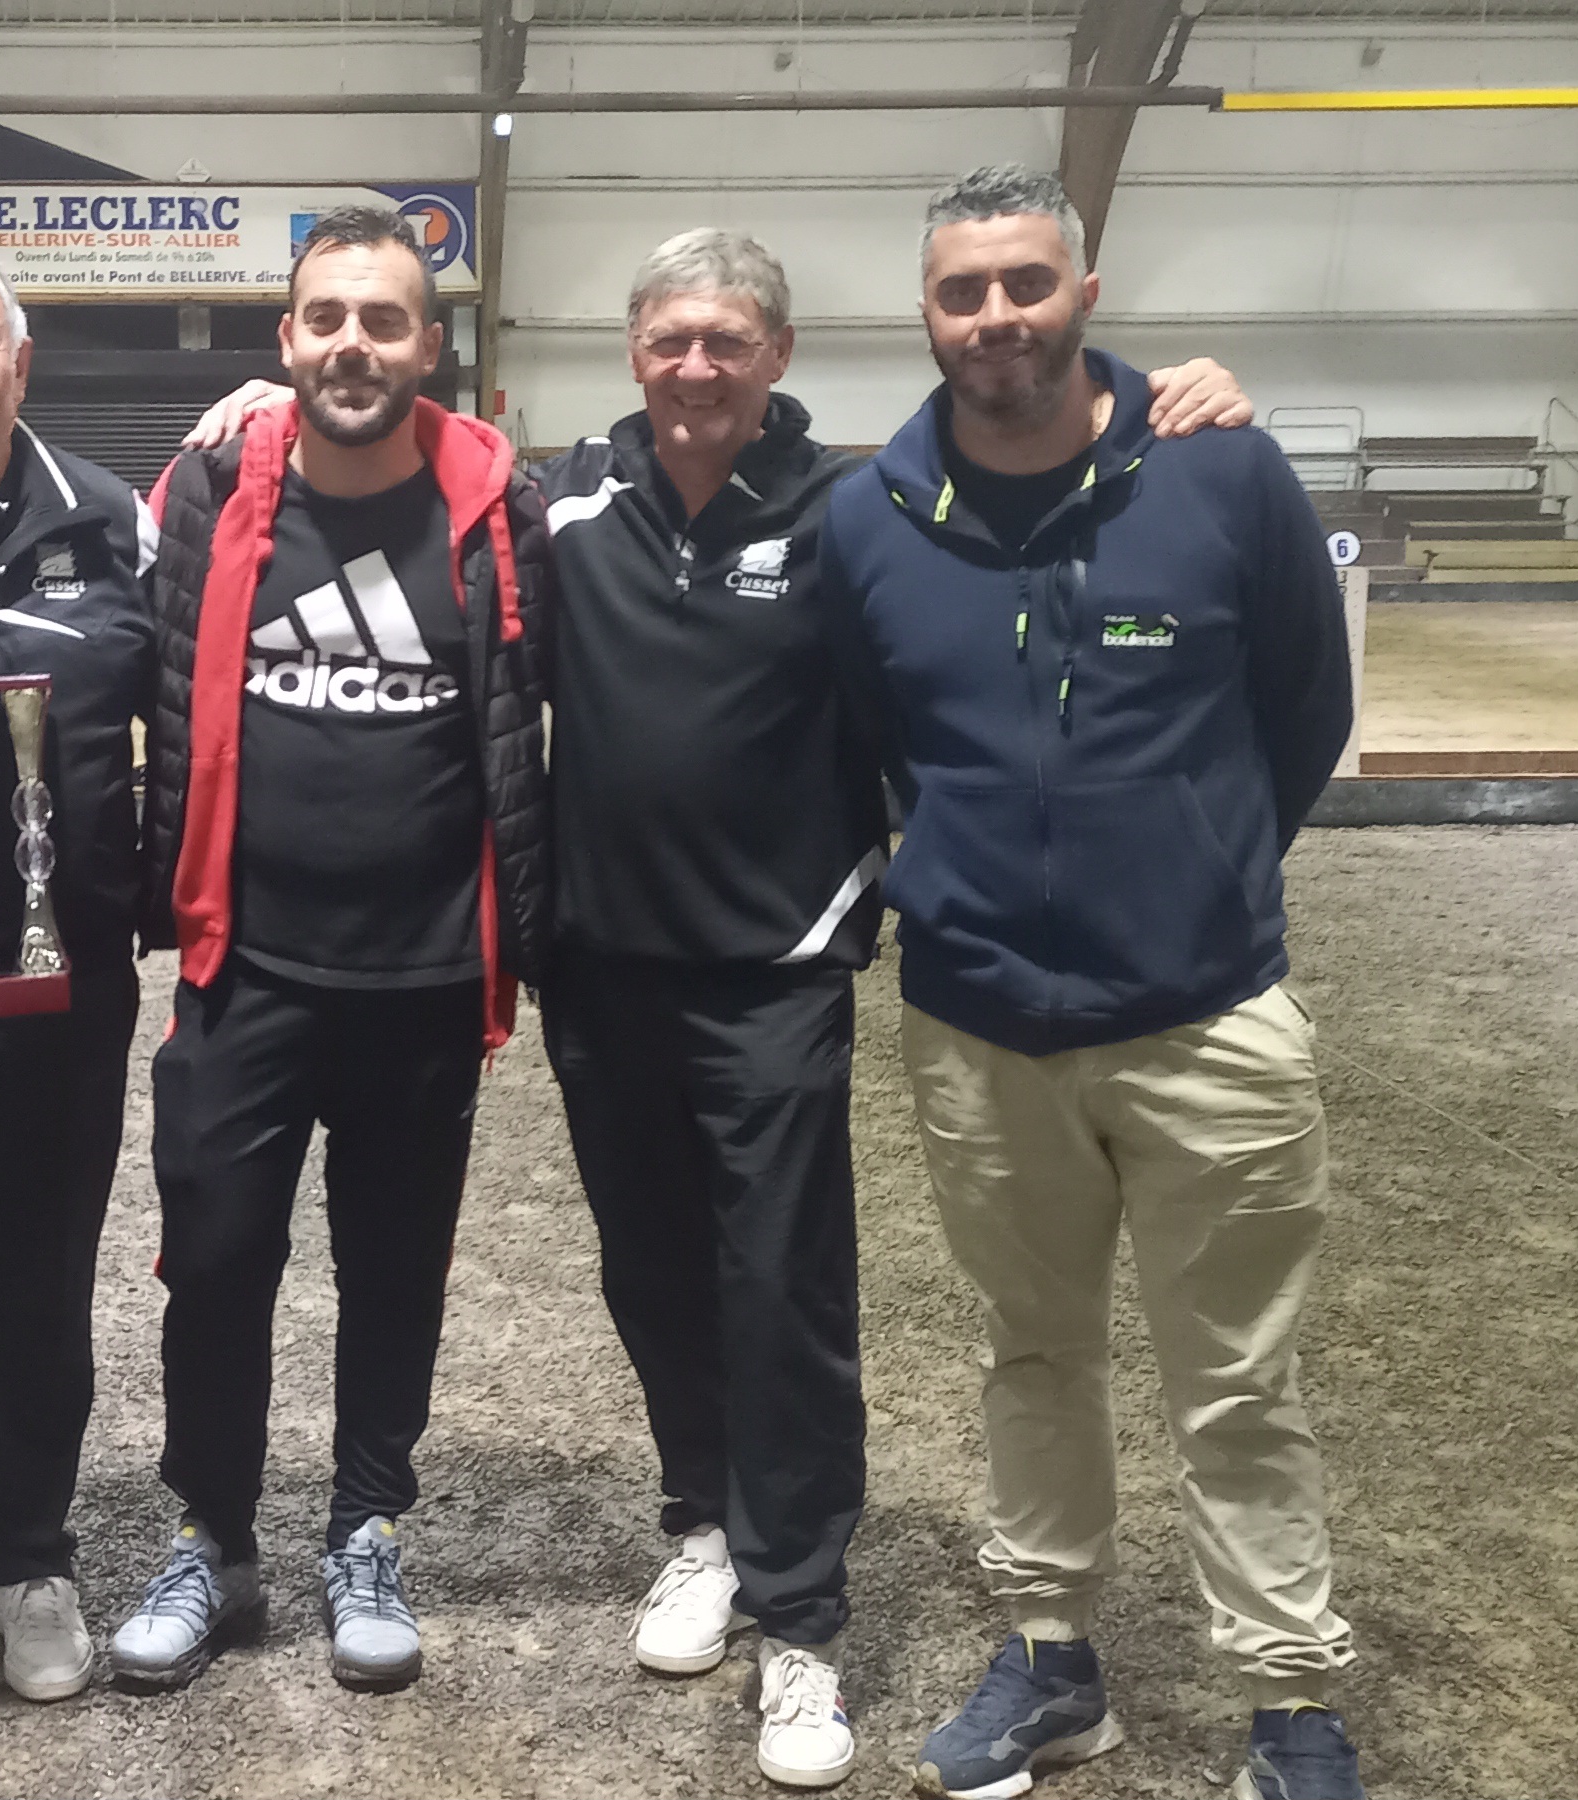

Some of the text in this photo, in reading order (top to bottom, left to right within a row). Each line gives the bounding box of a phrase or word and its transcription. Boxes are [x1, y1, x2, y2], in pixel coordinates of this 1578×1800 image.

[15, 250, 51, 262] Ouvert
[53, 251, 67, 262] du
[68, 251, 98, 262] Lundi
[115, 250, 153, 262] Samedi
[155, 251, 169, 262] de
[8, 269, 39, 283] oite
[43, 271, 86, 283] avant
[90, 269, 105, 283] le
[108, 270, 143, 283] Pont
[146, 270, 166, 283] de
[1336, 538, 1349, 559] 6
[30, 575, 88, 593] Cusset
[724, 570, 791, 594] Cusset
